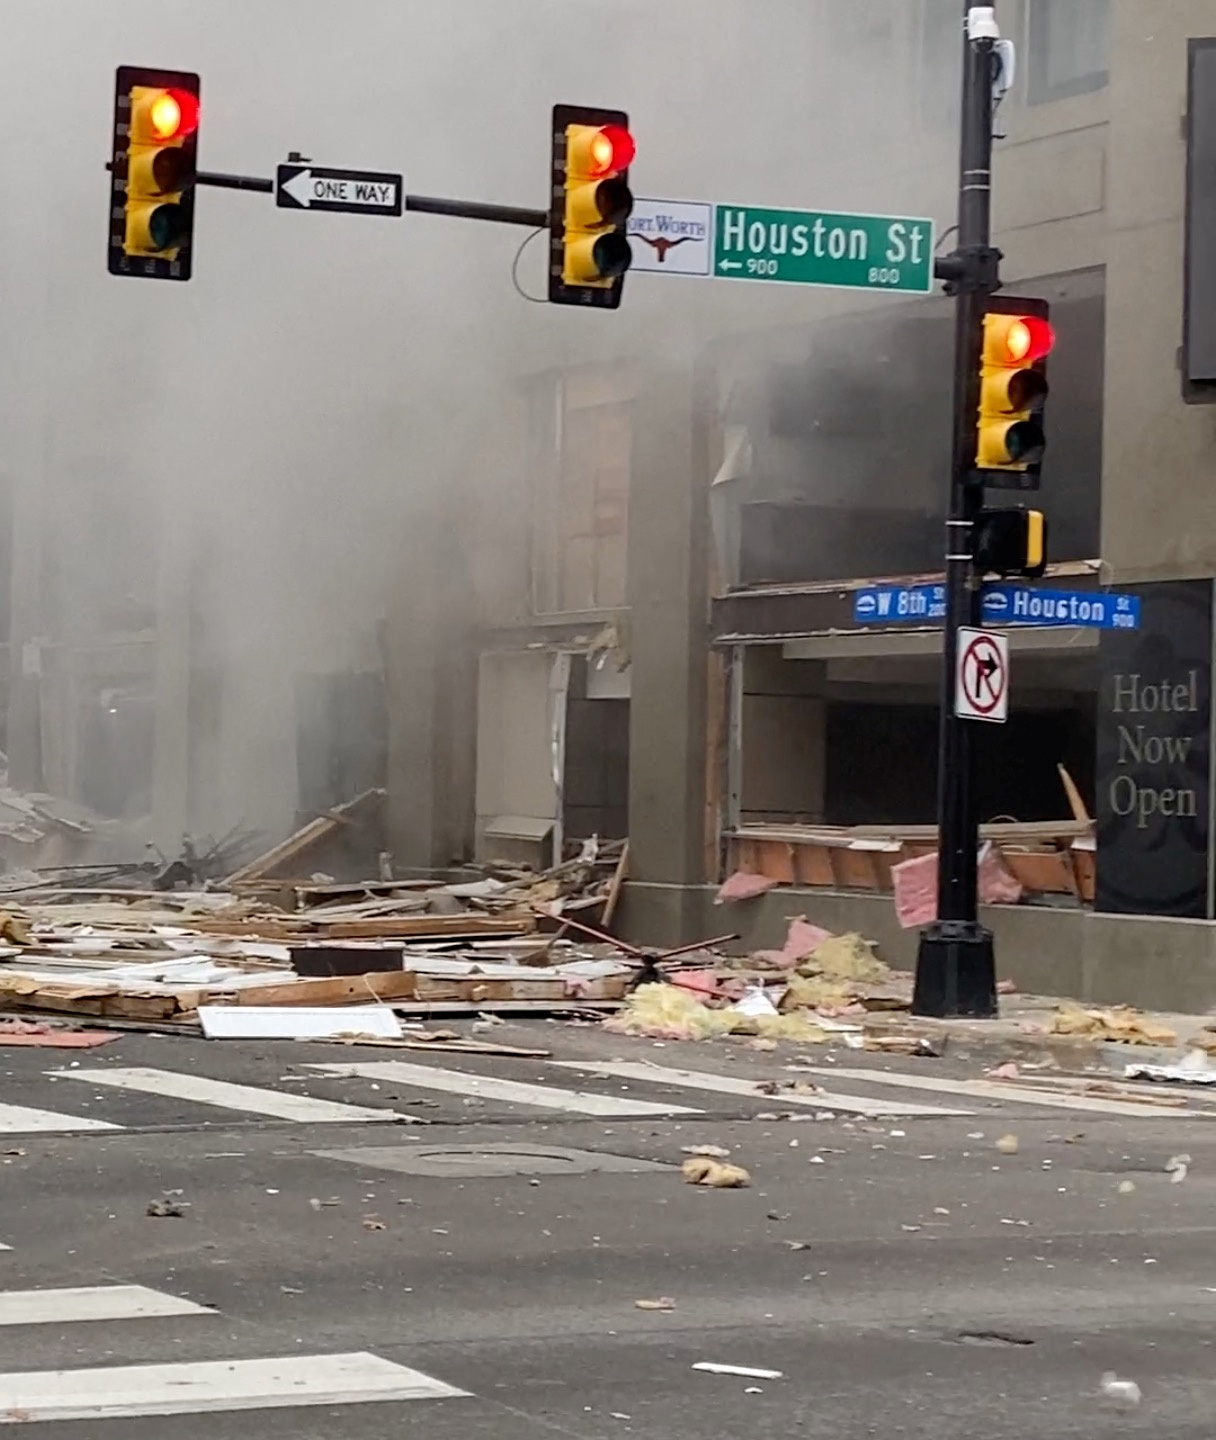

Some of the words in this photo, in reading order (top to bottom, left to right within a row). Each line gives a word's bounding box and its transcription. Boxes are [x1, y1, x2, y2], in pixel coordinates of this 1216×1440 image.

[314, 180, 347, 200] ONE
[356, 183, 390, 202] WAY
[628, 217, 653, 232] ORT
[722, 210, 868, 261] Houston
[885, 222, 923, 264] St
[746, 258, 778, 276] 900
[867, 267, 900, 284] 800
[877, 592, 892, 615] W
[897, 591, 927, 615] 8th
[1013, 591, 1105, 621] Houston
[1112, 613, 1135, 628] 900
[1112, 670, 1198, 713] Hotel
[1117, 725, 1193, 764] Now
[1109, 775, 1197, 829] Open
